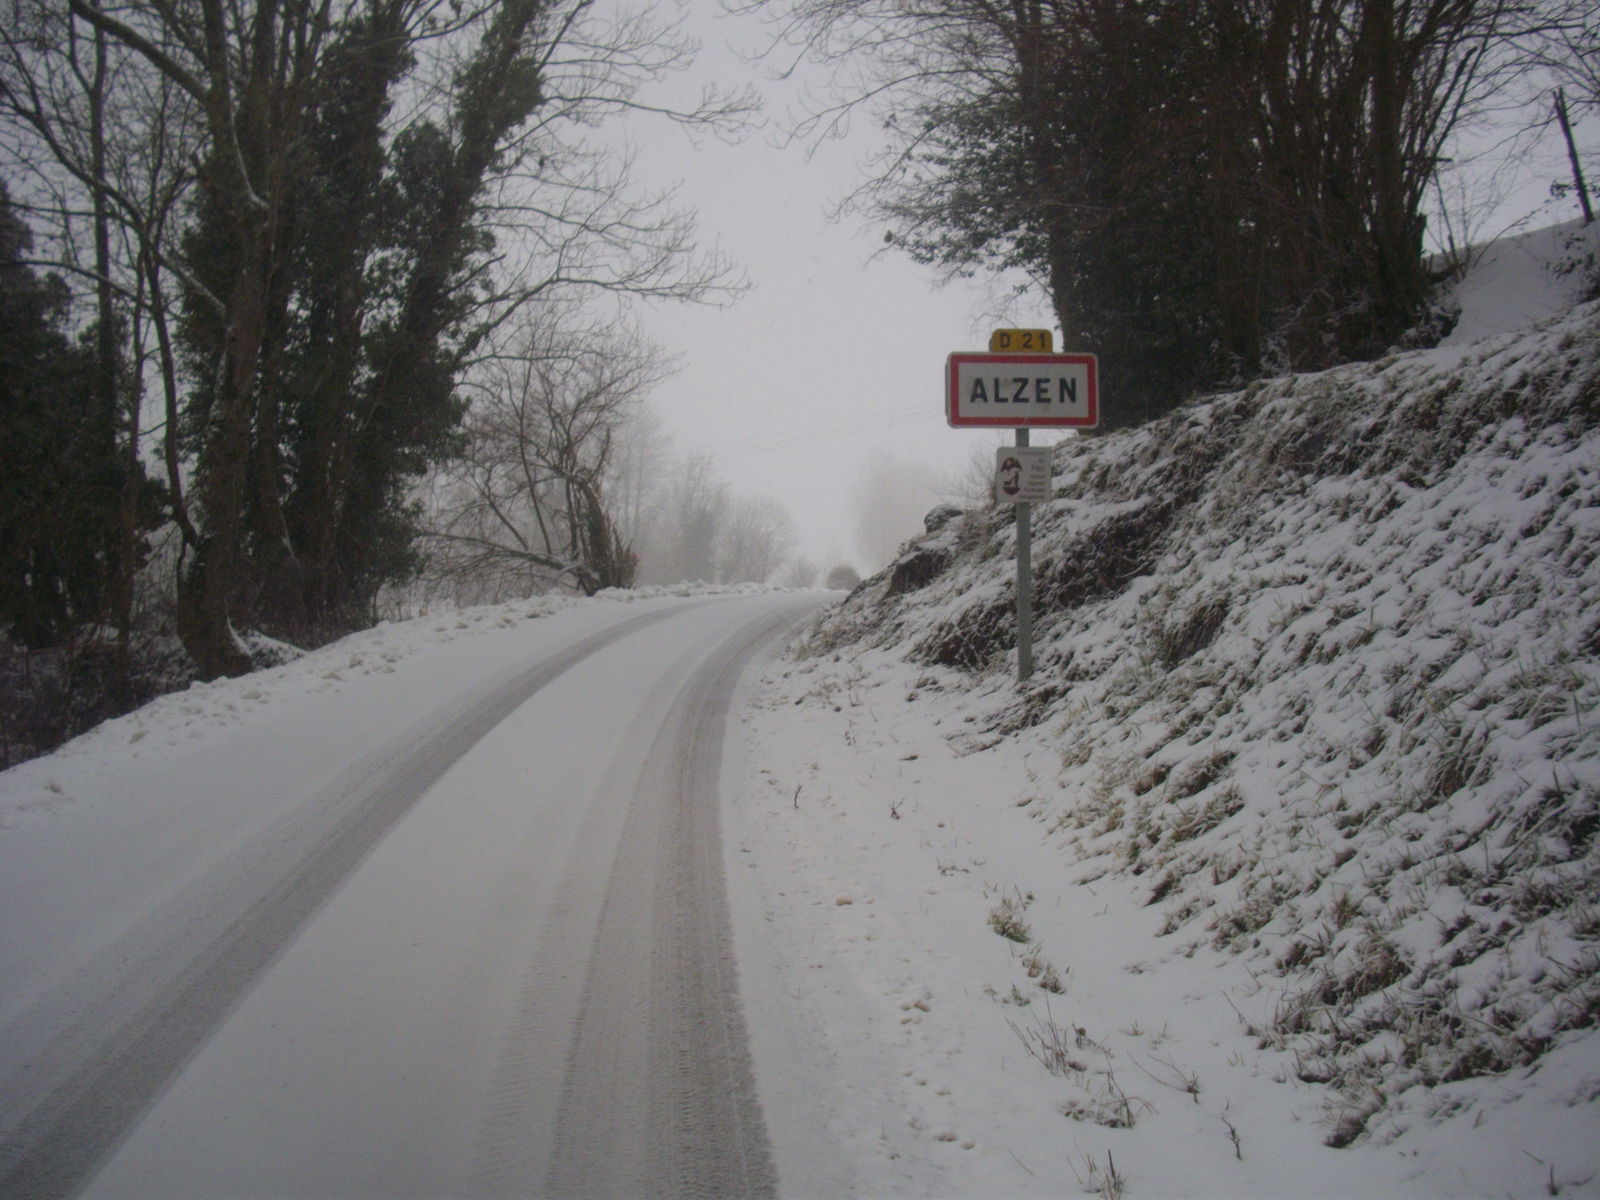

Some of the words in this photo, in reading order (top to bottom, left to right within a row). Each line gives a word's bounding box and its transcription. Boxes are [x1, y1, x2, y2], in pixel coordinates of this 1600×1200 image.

[1000, 333, 1010, 348] D
[1022, 333, 1046, 348] 21
[969, 377, 1077, 404] ALZEN
